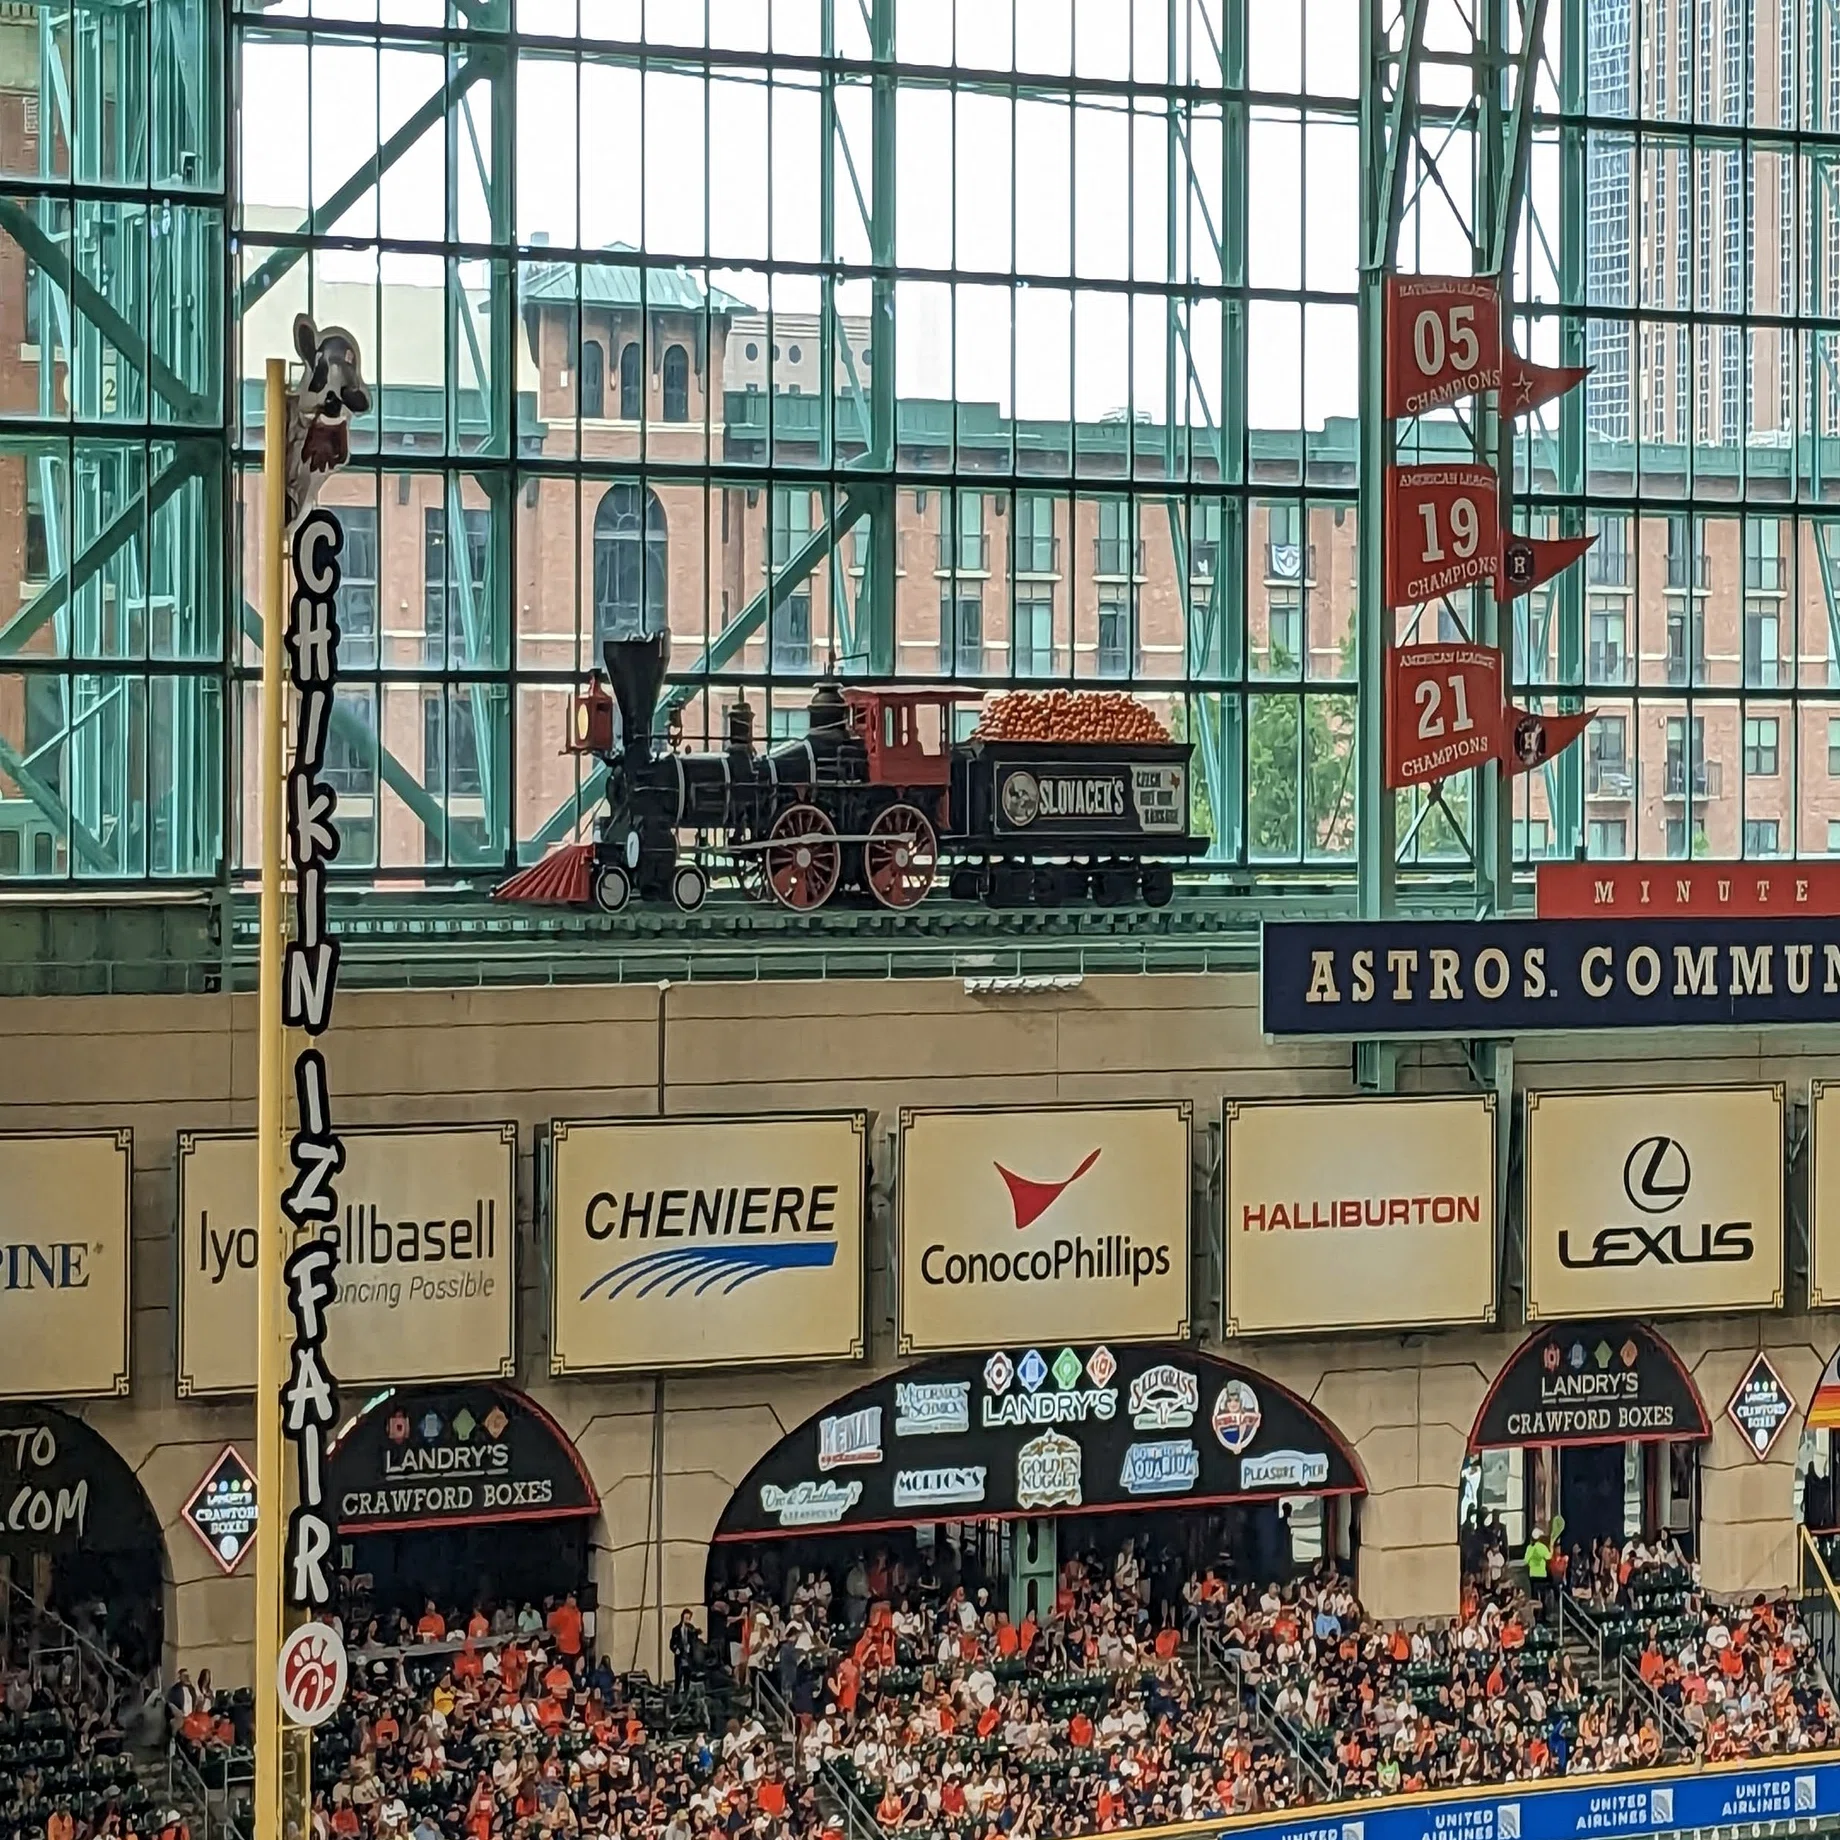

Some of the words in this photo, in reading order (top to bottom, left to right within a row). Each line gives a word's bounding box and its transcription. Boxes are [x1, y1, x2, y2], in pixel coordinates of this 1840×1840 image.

[1414, 305, 1479, 375] 05
[1406, 370, 1500, 412] CHAMPIONS
[1418, 498, 1479, 562] 19
[1407, 556, 1498, 598] CHAMPIONS
[1415, 675, 1473, 740] 21
[289, 520, 336, 1025] CHIKIN
[1402, 736, 1488, 776] CHAMPIONS
[1038, 777, 1124, 815] SLOVACEK'S
[1594, 880, 1808, 903] MINUTE
[585, 1185, 838, 1240] CHENIERE
[1242, 1195, 1480, 1232] HALLIBURTON
[200, 1199, 494, 1284] lyoellbasell
[1558, 1222, 1754, 1269] LEXUS
[0, 1242, 90, 1289] INE
[921, 1235, 1170, 1287] ConocoPhillips
[409, 1270, 495, 1300] Possible
[1541, 1372, 1638, 1397] LANDRY'S
[984, 1389, 1117, 1426] LANDRY'S
[1507, 1408, 1611, 1435] CRAWFORD
[1618, 1406, 1674, 1428] BOXES
[0, 1426, 56, 1471] TO
[385, 1443, 509, 1473] LANDRY'S
[341, 1486, 473, 1516] CRAWFORD
[483, 1480, 552, 1508] BOXES
[1021, 1471, 1076, 1489] NUGGET
[1590, 1793, 1647, 1812] UNITED
[1722, 1796, 1790, 1816] AIRLINES
[1736, 1781, 1790, 1799] UNITED
[1435, 1810, 1493, 1829] UNITED
[1576, 1809, 1647, 1830] AIRLINES
